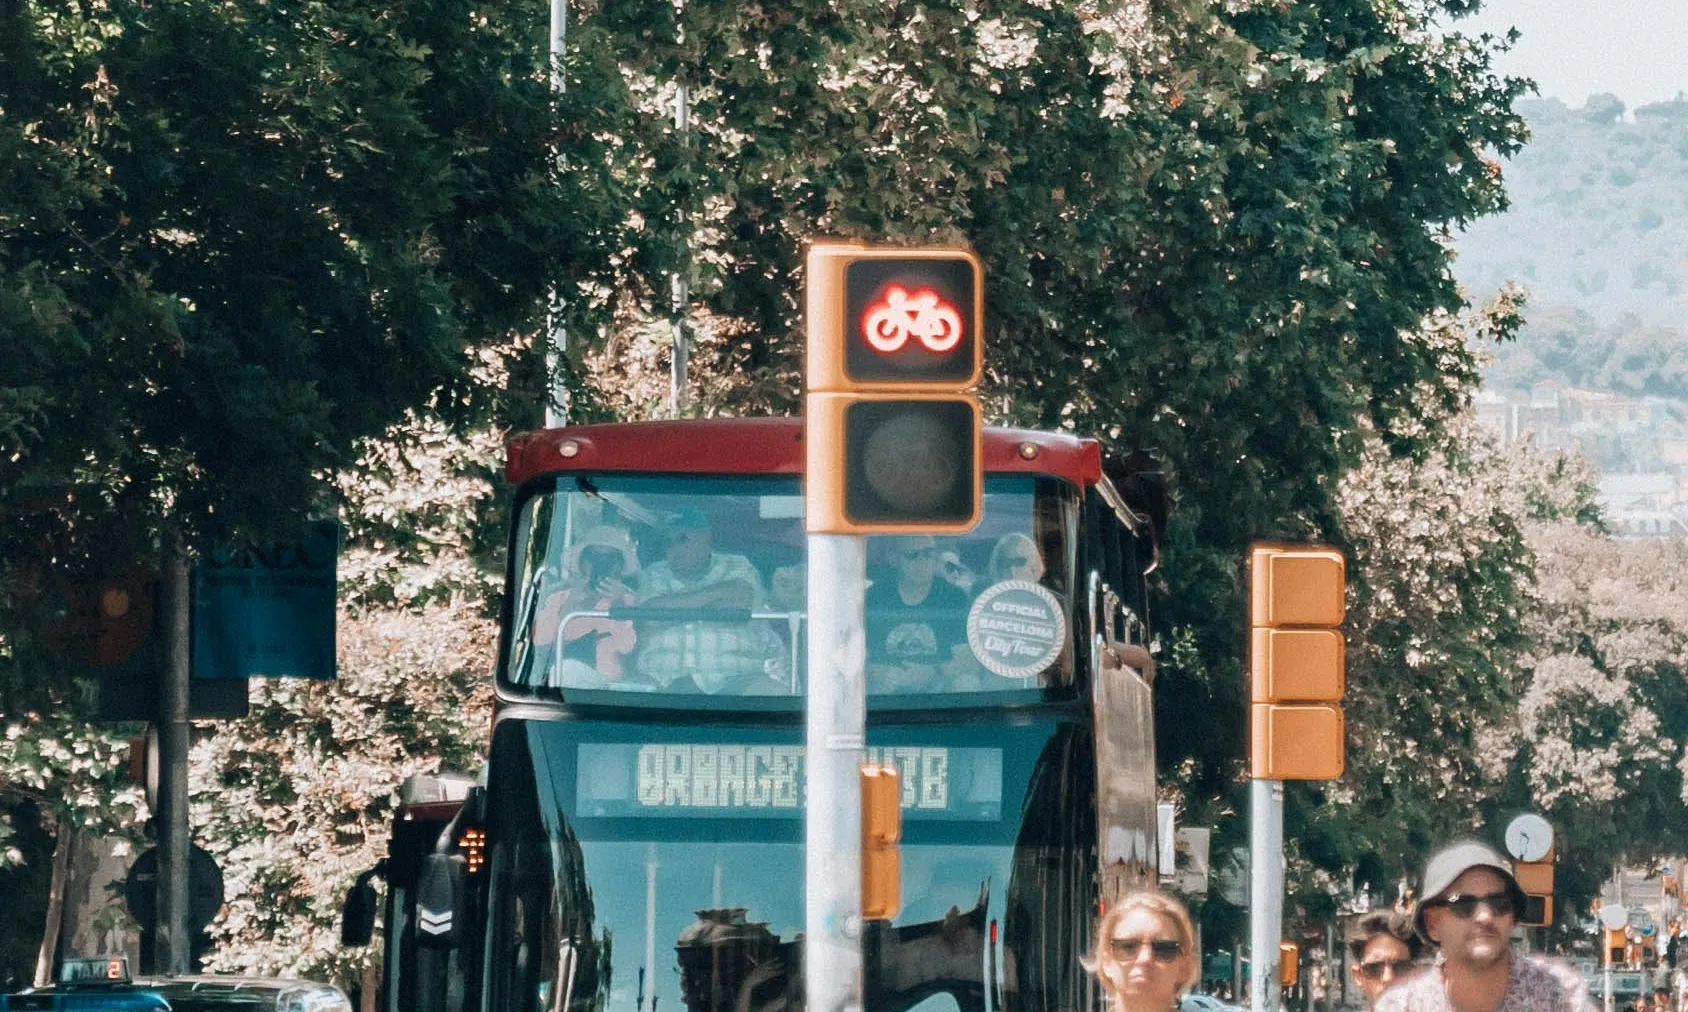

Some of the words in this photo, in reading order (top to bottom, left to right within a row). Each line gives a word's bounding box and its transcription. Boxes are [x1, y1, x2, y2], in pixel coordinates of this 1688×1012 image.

[992, 602, 1048, 619] OFFICIAL
[979, 619, 1054, 638] BARCELONA
[107, 960, 121, 979] 2
